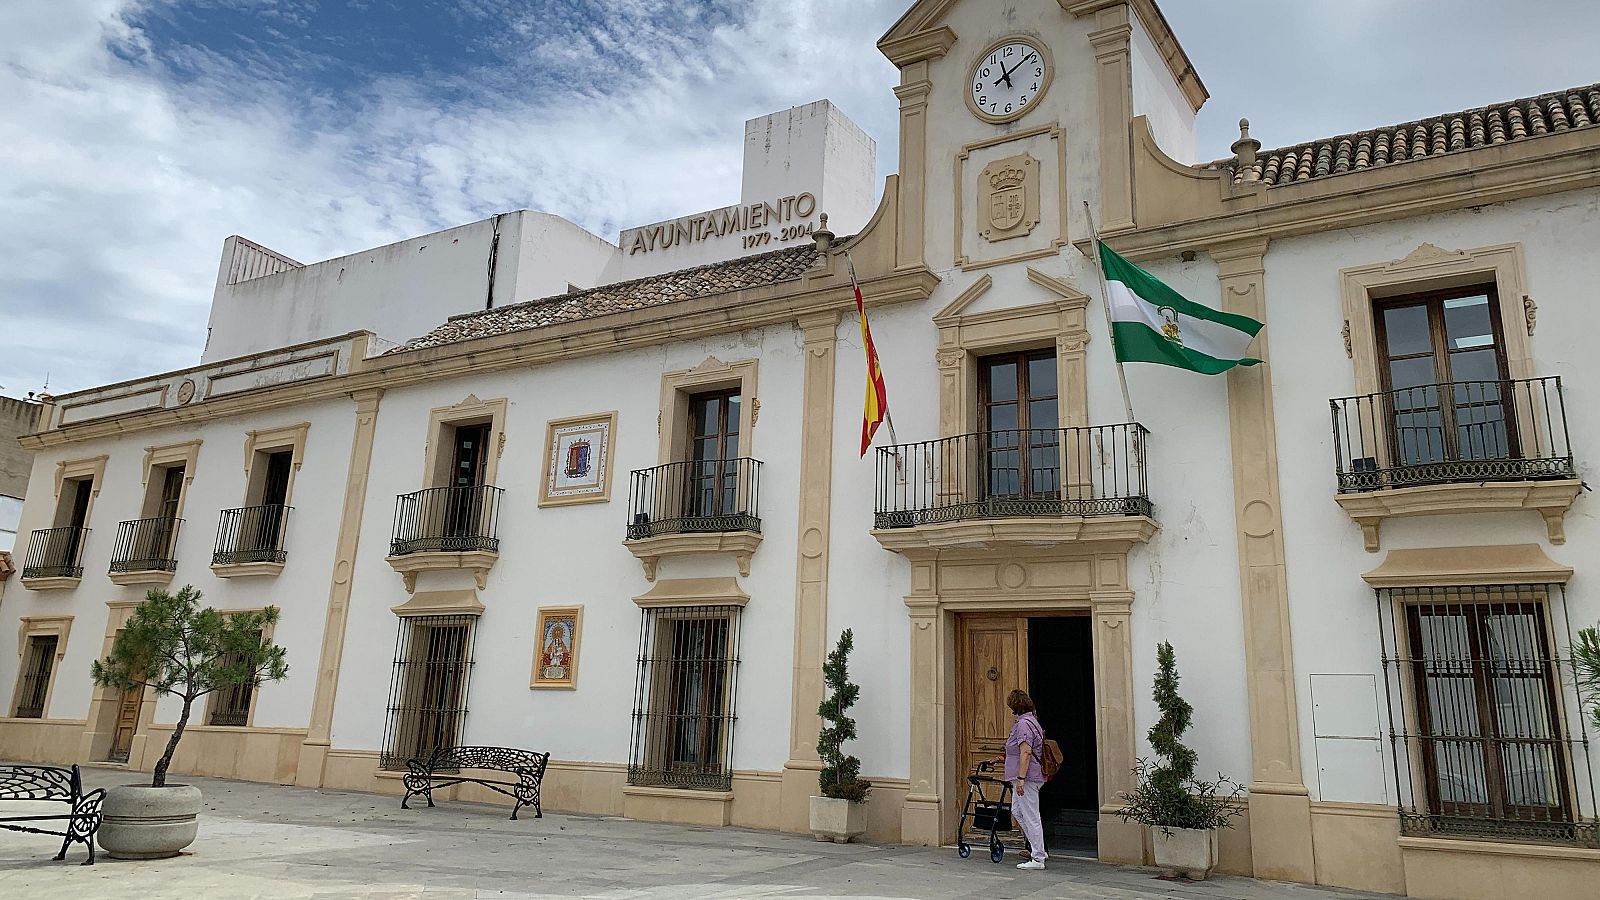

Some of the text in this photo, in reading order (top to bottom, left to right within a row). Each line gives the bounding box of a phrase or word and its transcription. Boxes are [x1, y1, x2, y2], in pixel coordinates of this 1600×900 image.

[1003, 47, 1014, 57] 12
[990, 55, 996, 65] 11
[1030, 55, 1037, 64] 2
[979, 68, 990, 78] 10
[1034, 67, 1042, 77] 3
[975, 82, 983, 92] 9
[1030, 82, 1038, 91] 4
[979, 96, 986, 105] 8
[1019, 95, 1027, 105] 5
[990, 103, 997, 112] 7
[1005, 103, 1012, 113] 6
[630, 192, 816, 255] AYUNTAMIENTO
